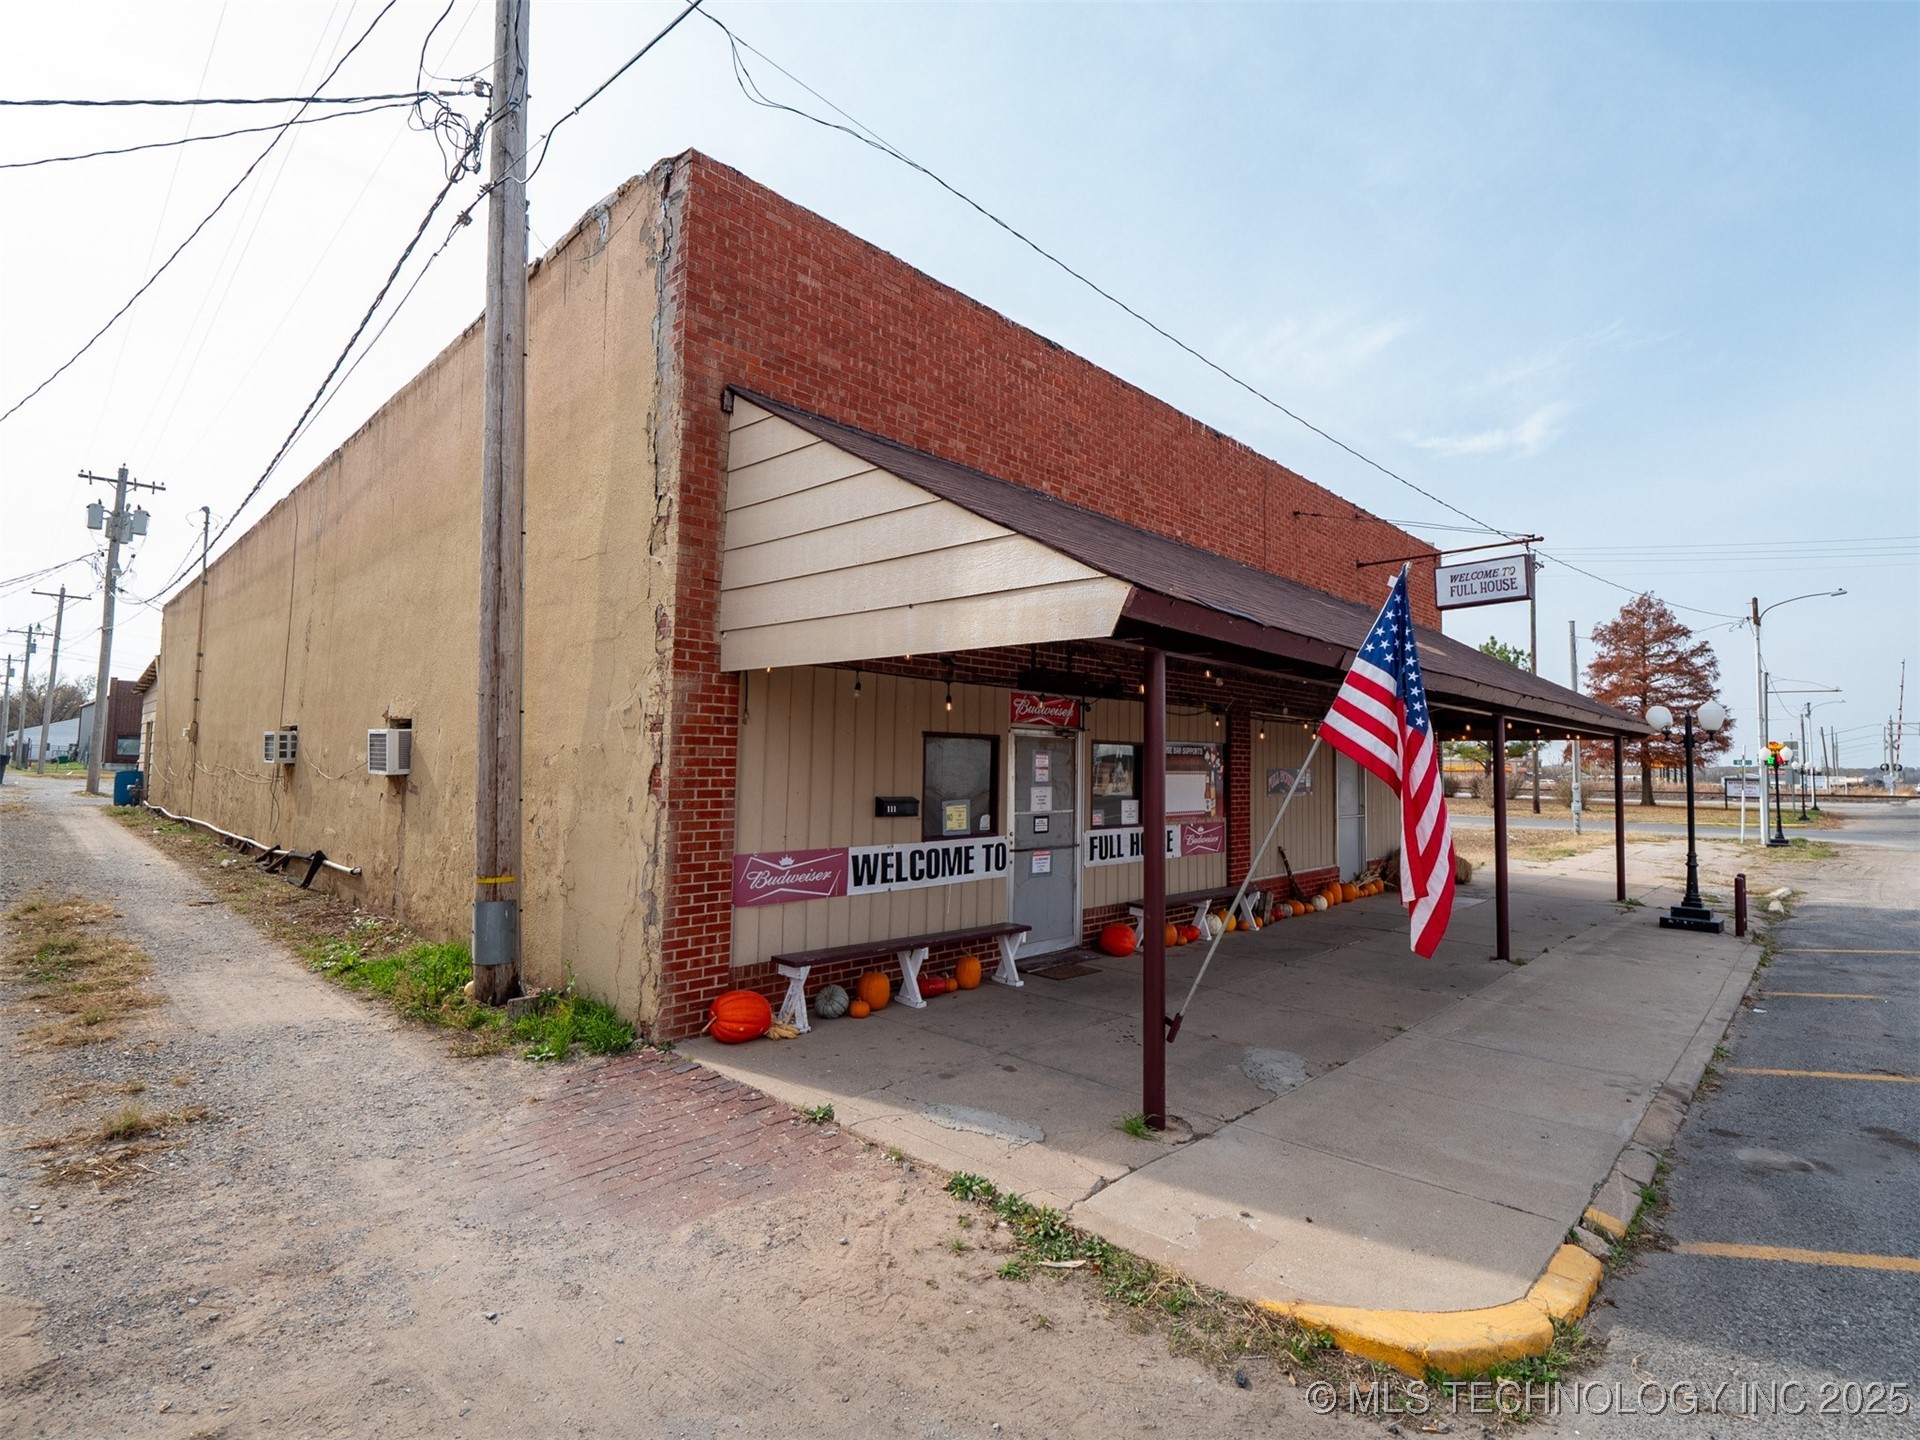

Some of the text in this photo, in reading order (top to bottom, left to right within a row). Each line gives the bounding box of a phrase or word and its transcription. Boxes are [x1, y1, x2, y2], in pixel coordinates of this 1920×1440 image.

[1450, 566, 1515, 583] WELCOME TO
[1450, 577, 1518, 597] FULL HOUSE
[1013, 697, 1073, 717] Budweiser
[1182, 747, 1203, 755] SUPPORTS
[1089, 834, 1124, 861] FULL
[1185, 834, 1219, 846] Budweiser
[746, 868, 832, 890] Budweiser
[851, 845, 976, 888] WELCOME
[981, 842, 1007, 873] TO
